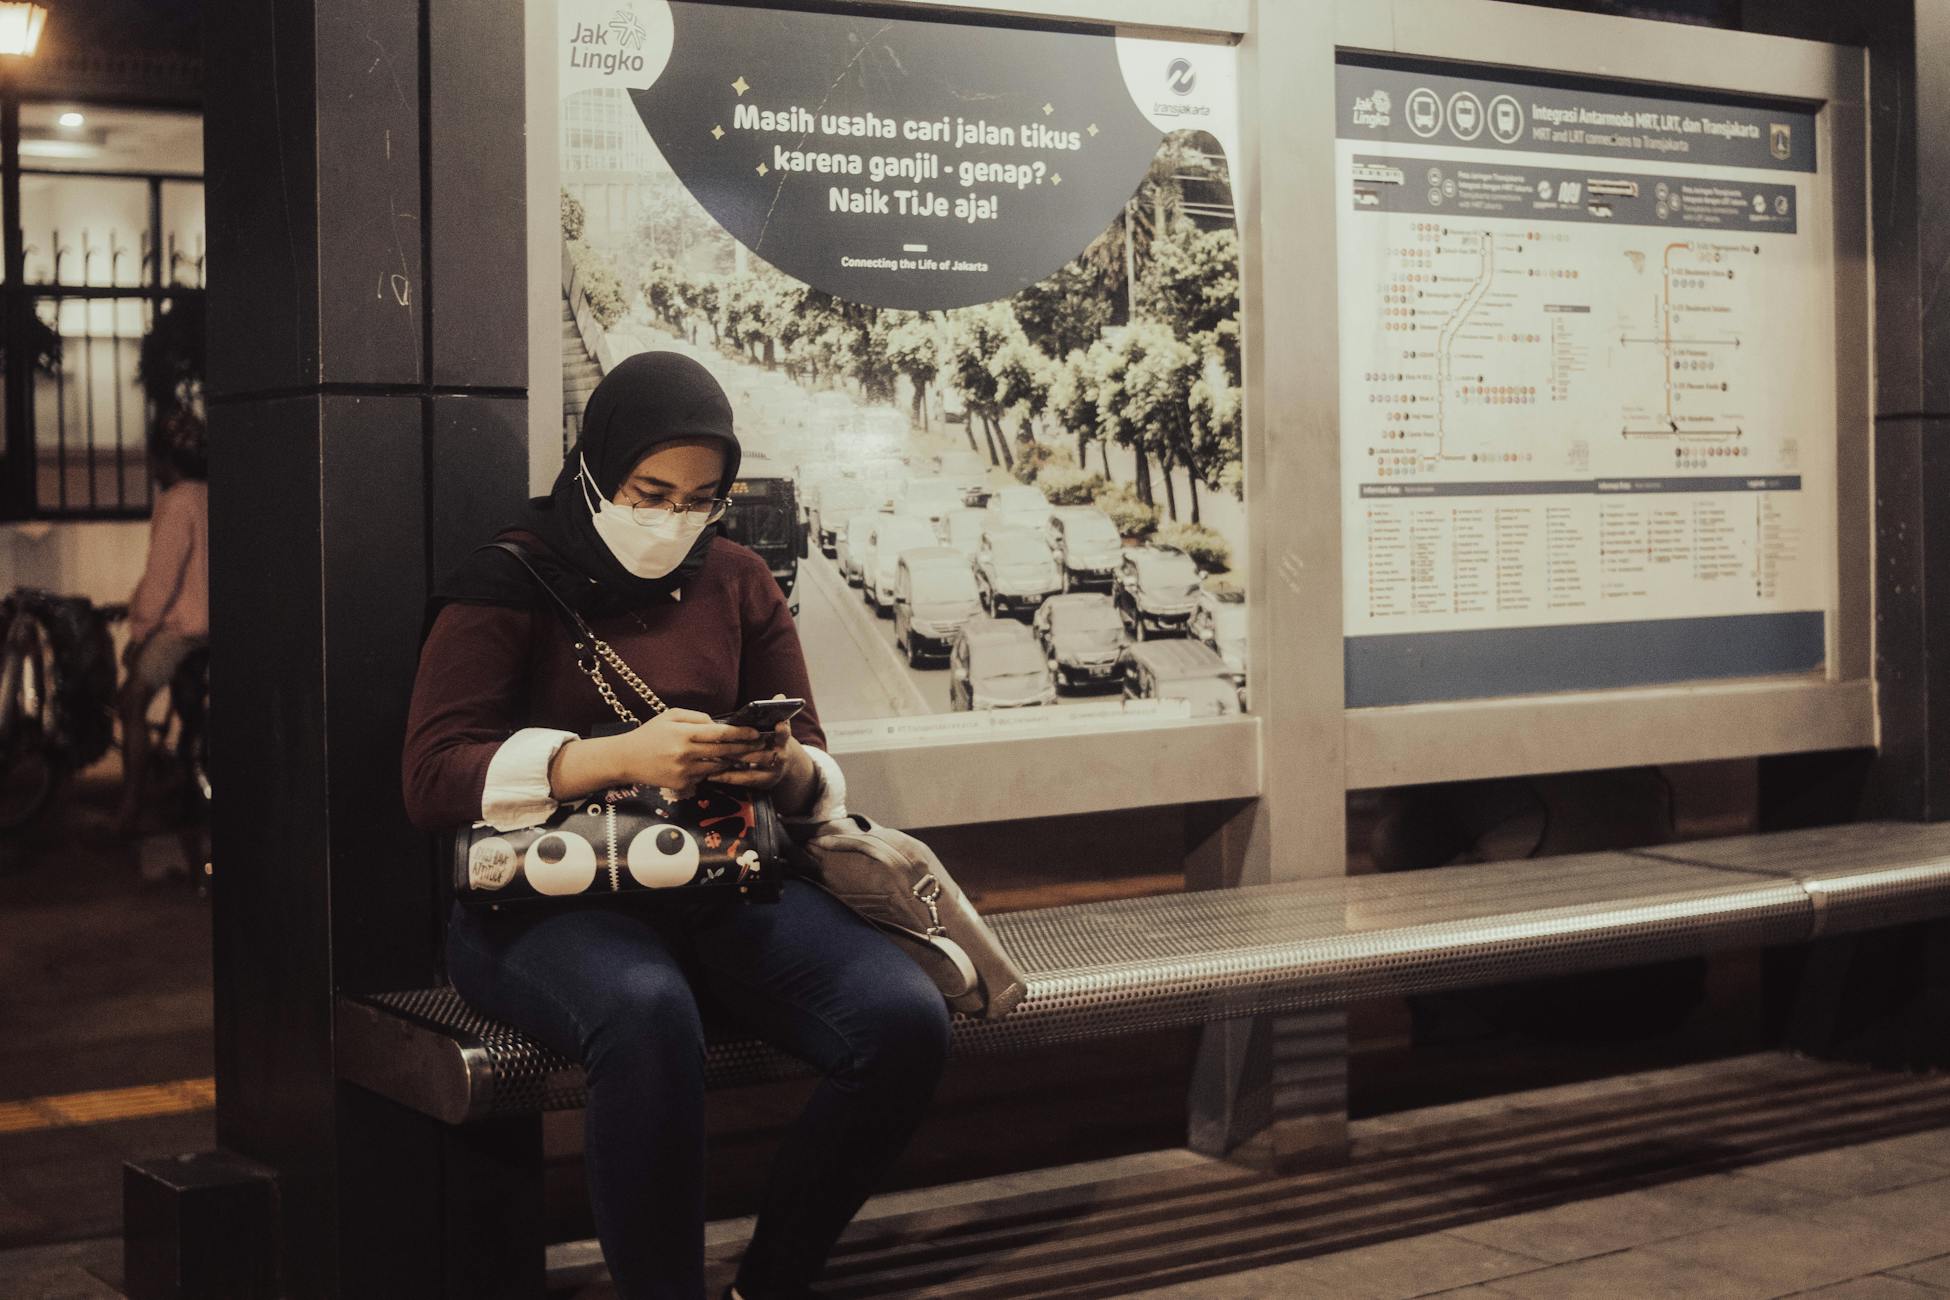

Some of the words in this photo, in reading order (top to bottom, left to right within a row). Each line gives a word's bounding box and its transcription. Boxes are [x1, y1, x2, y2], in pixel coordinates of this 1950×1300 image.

[570, 22, 608, 45] Jak
[570, 46, 644, 76] Lingko
[733, 103, 815, 134] Masih
[821, 112, 897, 139] usaha
[903, 116, 950, 142] cari
[955, 117, 1015, 148] jalan
[1020, 122, 1081, 151] tikus
[1532, 104, 1578, 126] Integrasi
[1579, 107, 1634, 129] Antarmoda
[1635, 112, 1660, 132] MRT,
[1660, 114, 1682, 134] LRT,
[1682, 117, 1701, 134] dan
[1701, 118, 1760, 140] Transjakarta
[773, 144, 863, 175] karena
[868, 151, 938, 184] ganjil
[958, 160, 1047, 190] genap?
[828, 186, 889, 214] Naik
[893, 188, 950, 217] TiJe
[954, 192, 998, 224] aja!
[840, 255, 898, 271] Connecting
[899, 258, 917, 270] the
[917, 258, 938, 270] Life
[938, 259, 951, 270] of
[951, 261, 989, 272] Jakarta
